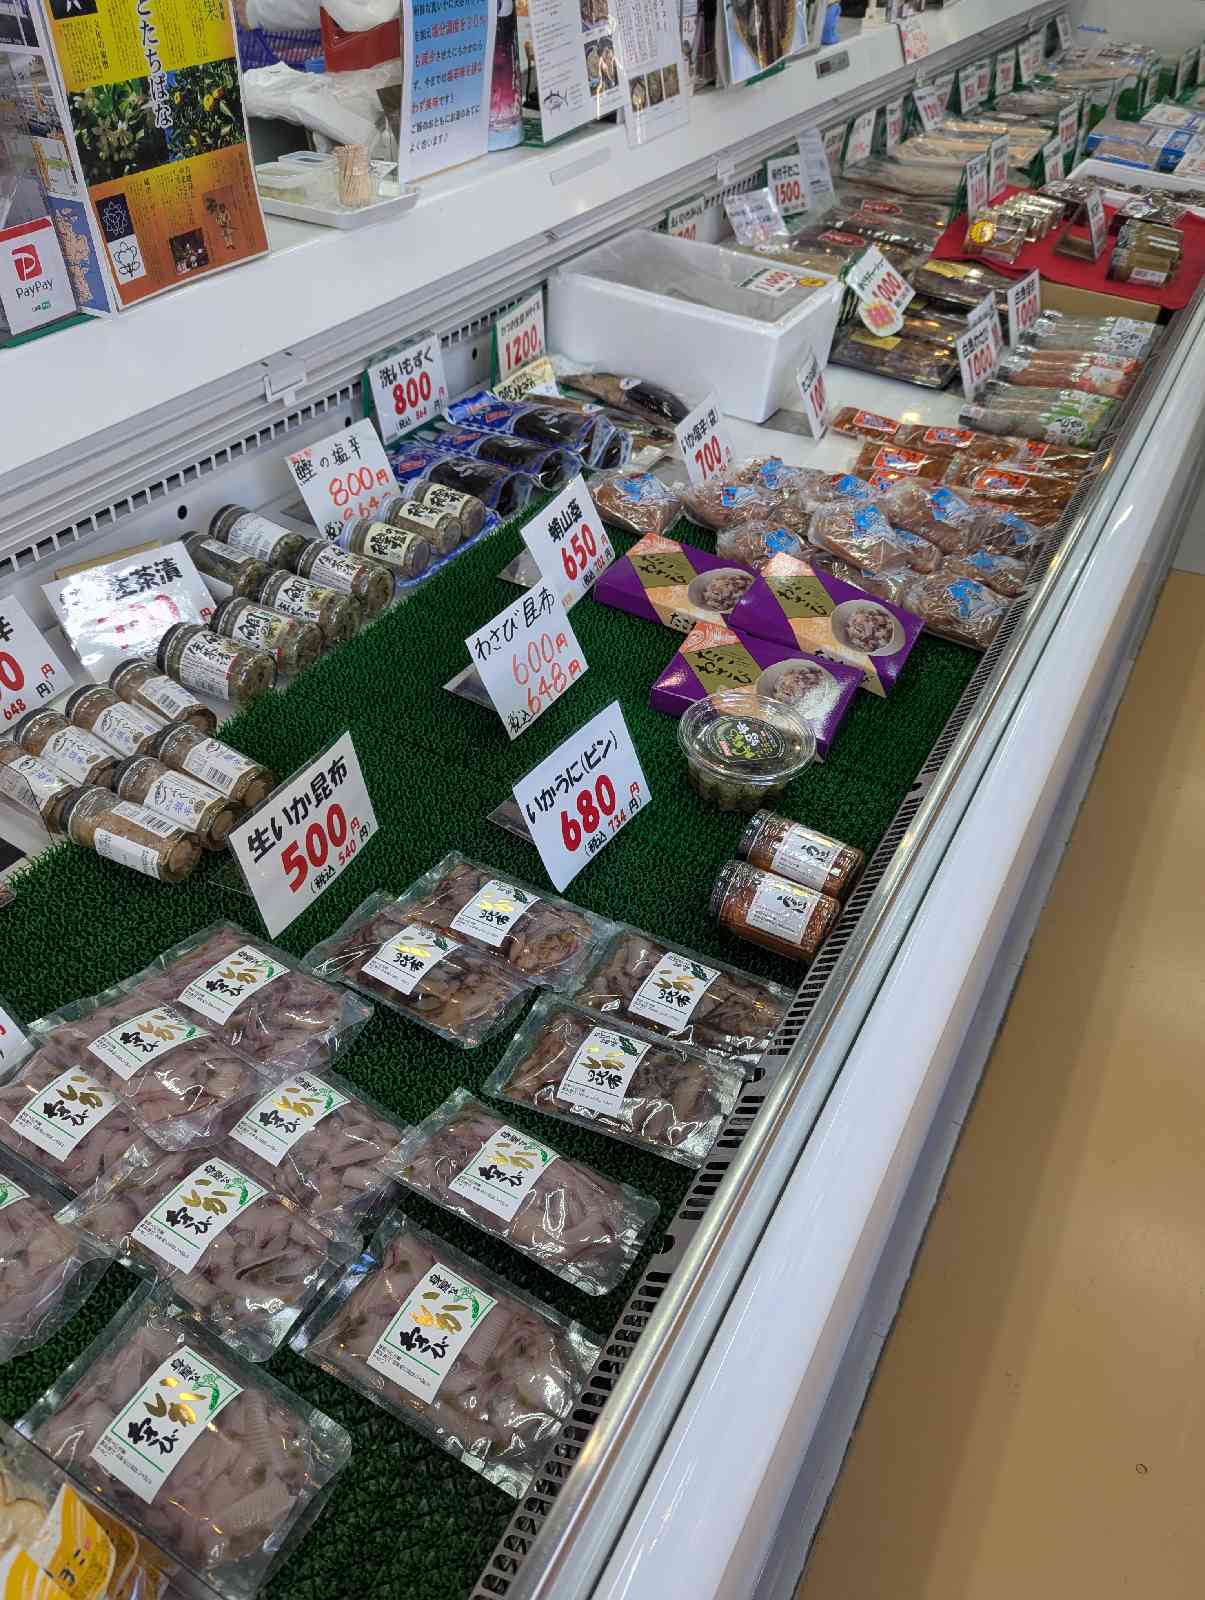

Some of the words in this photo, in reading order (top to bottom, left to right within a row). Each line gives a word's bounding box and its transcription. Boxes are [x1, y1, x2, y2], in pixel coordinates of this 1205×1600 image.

[16, 279, 53, 299] PayPay
[379, 346, 433, 389] 洗いもずく
[474, 586, 555, 661] わさび昆布
[248, 756, 347, 864] 生いか昆布
[526, 730, 618, 825] いかうに(ビン)
